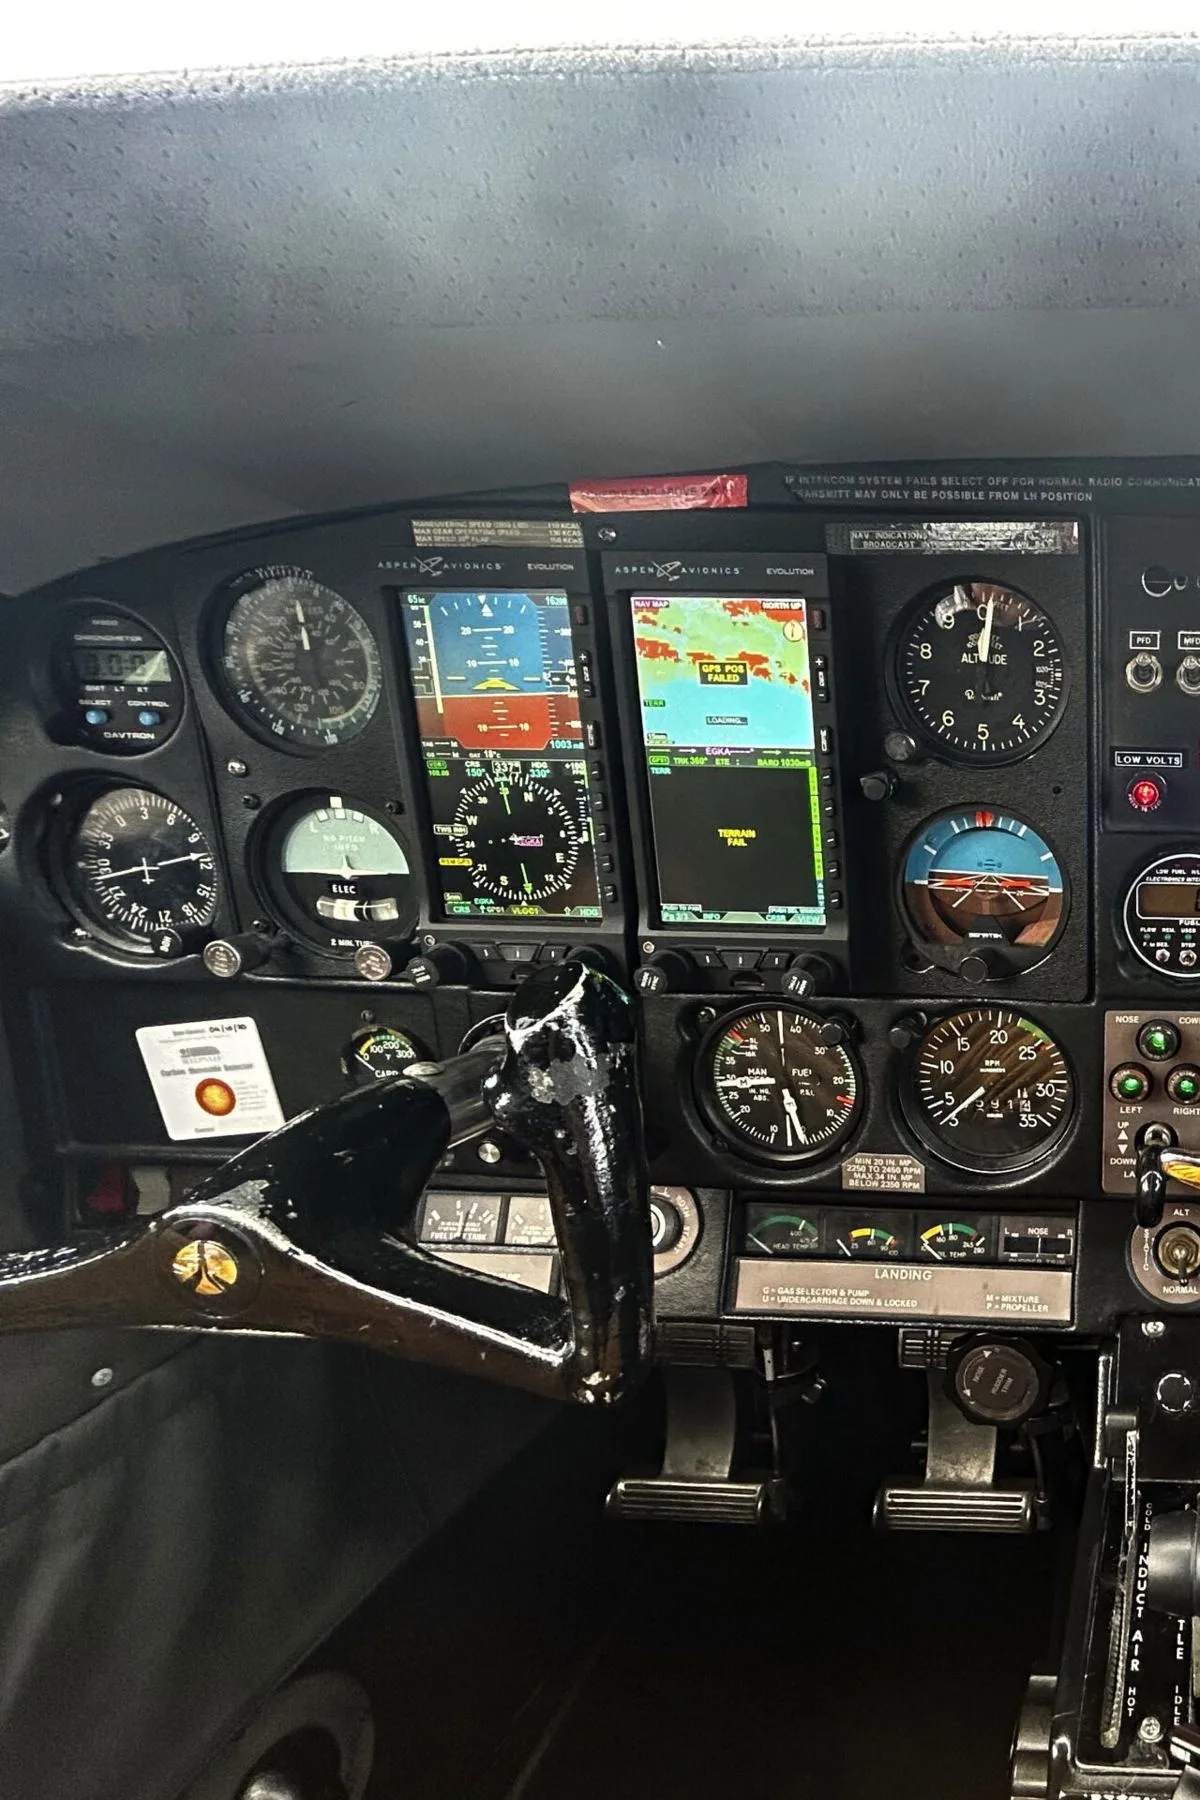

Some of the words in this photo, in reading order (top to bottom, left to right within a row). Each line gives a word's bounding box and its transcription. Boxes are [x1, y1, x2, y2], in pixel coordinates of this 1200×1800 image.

[855, 490, 877, 499] MAY
[882, 490, 909, 500] ONLY
[913, 490, 928, 500] BE
[932, 490, 984, 501] POSSIBLE
[988, 491, 1019, 501] FROM
[1024, 491, 1037, 501] LH
[1040, 492, 1092, 502] POSITION
[702, 664, 721, 673] GPS
[725, 665, 744, 673] POS
[708, 673, 740, 682] FAILED
[706, 747, 730, 755] EGKA
[1147, 756, 1180, 765] VOLTS
[718, 829, 756, 838] TERRAIN
[727, 838, 747, 846] FAIL
[875, 1269, 932, 1281] LANDING
[796, 1288, 838, 1296] SELECTOR
[1163, 1286, 1199, 1295] NORMAL
[777, 1295, 847, 1305] UNDERCARRIAGE
[850, 1298, 875, 1306] DOWN
[1001, 1295, 1040, 1303] MIXTURE
[1001, 1303, 1048, 1312] PROPELLER
